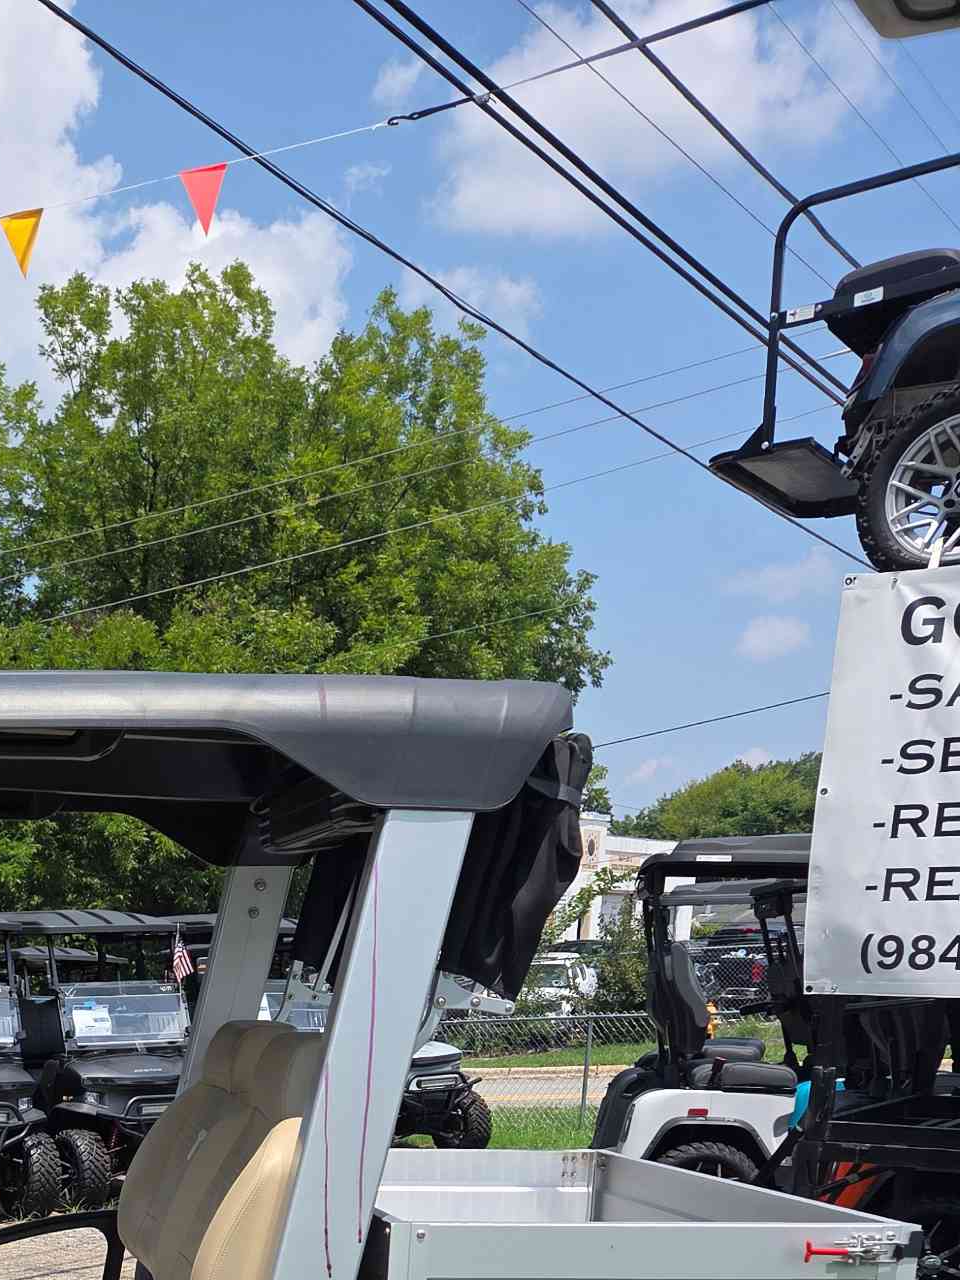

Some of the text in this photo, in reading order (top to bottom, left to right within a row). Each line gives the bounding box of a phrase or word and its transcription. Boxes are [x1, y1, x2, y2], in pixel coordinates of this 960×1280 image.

[901, 596, 960, 645] G
[865, 866, 960, 901] -RE
[860, 934, 960, 974] (984
